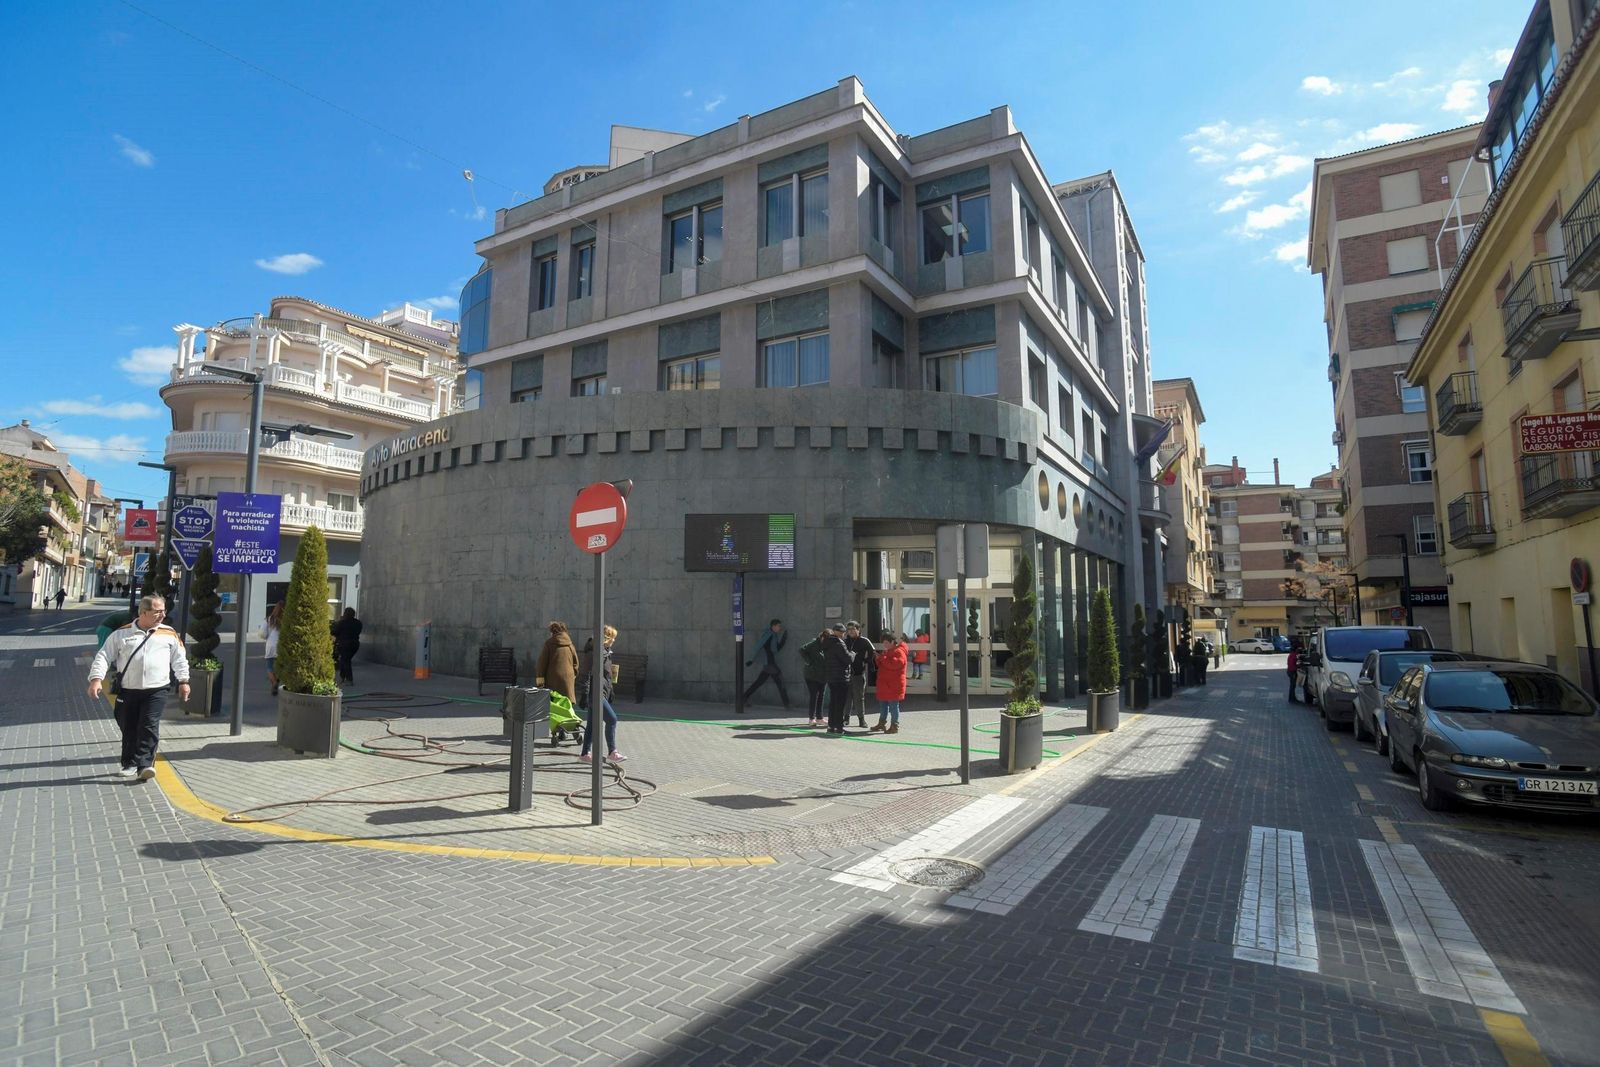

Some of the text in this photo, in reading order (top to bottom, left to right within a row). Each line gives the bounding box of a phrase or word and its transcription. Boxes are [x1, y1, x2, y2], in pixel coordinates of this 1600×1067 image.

[1522, 417, 1543, 427] Angel
[1546, 416, 1556, 424] M.
[1558, 414, 1585, 424] Legaza
[1522, 425, 1582, 436] SEGUROS
[1524, 432, 1600, 444] ASESORIA FIS
[372, 426, 450, 468] Ayto Maracena
[1524, 443, 1563, 451] LABORAL
[179, 516, 210, 526] STOP
[234, 540, 260, 548] #ESTE
[216, 548, 276, 556] AYUNTAMIENTO
[232, 555, 274, 564] IMPLICA
[1526, 780, 1594, 793] GR 1213 AZ
